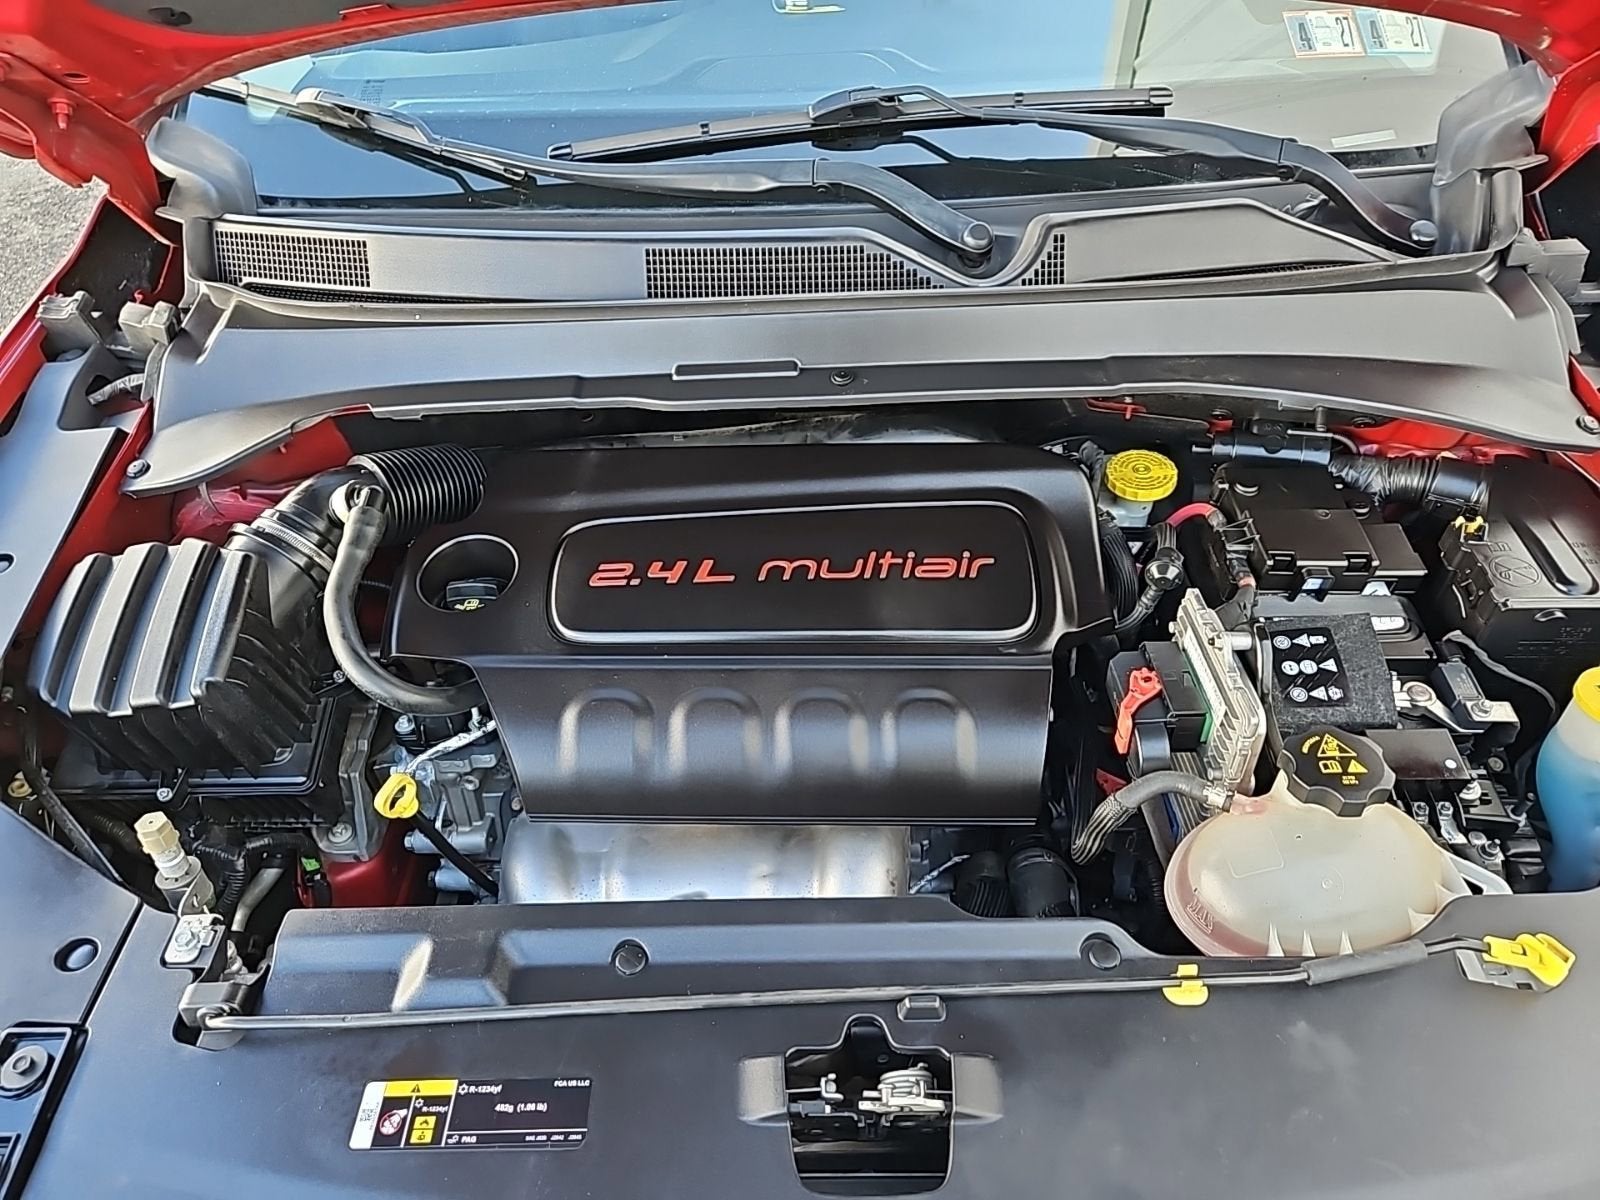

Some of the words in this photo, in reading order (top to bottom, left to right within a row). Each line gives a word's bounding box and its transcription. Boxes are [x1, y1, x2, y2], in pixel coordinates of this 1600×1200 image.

[1298, 22, 1313, 50] 4
[1369, 20, 1384, 48] 4
[757, 551, 995, 581] multiair
[468, 1084, 503, 1095] R-1234yf
